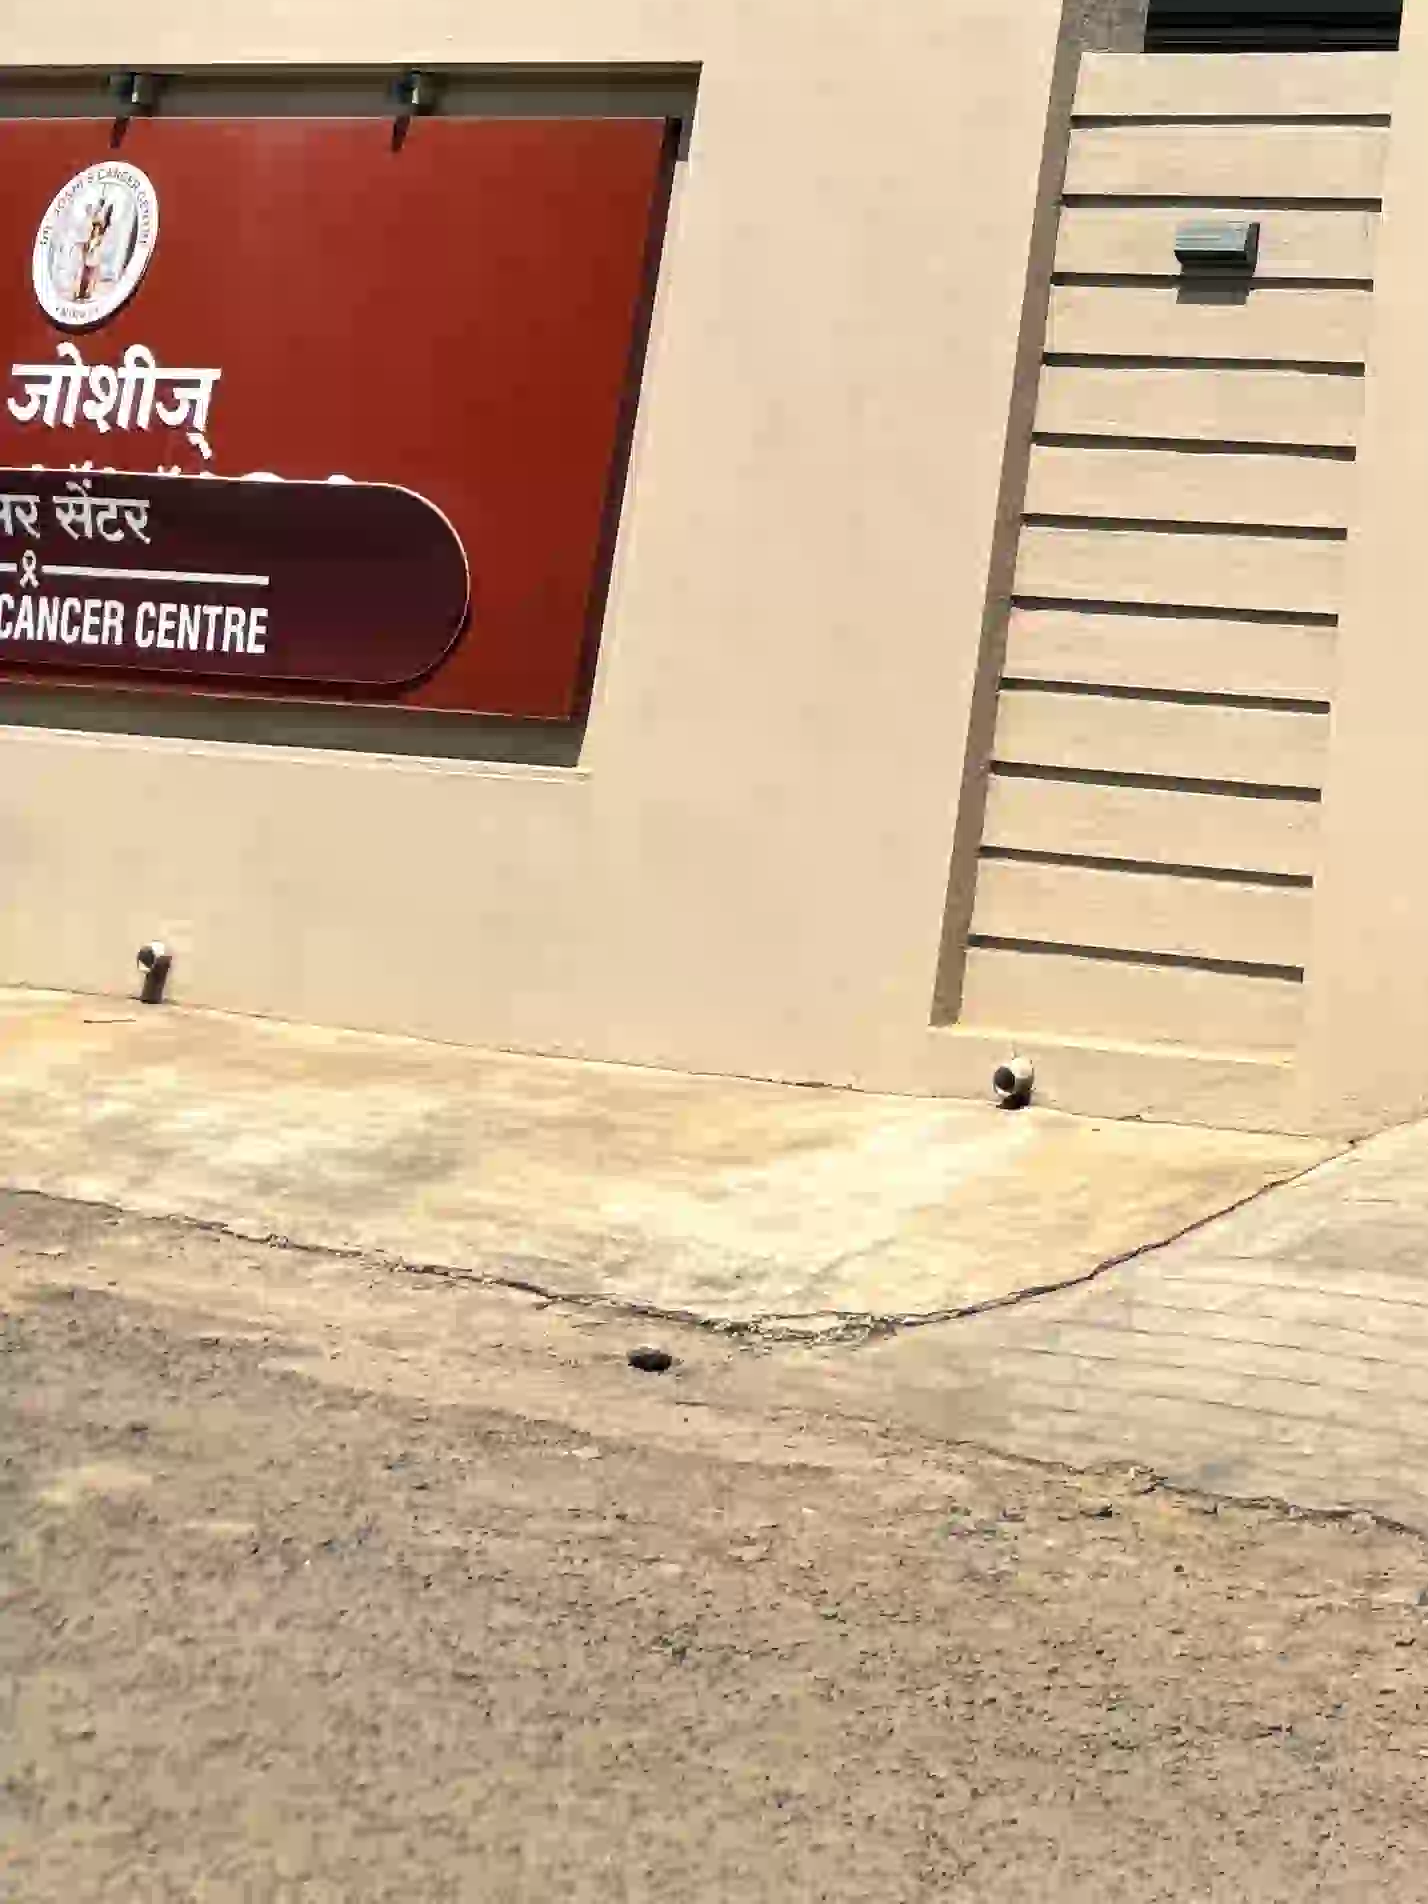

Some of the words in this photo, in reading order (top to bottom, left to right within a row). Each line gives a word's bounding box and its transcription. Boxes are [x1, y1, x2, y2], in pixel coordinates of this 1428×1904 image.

[53, 478, 150, 544] सेंटर
[0, 593, 125, 645] CANCER
[135, 601, 269, 654] CENTRE
